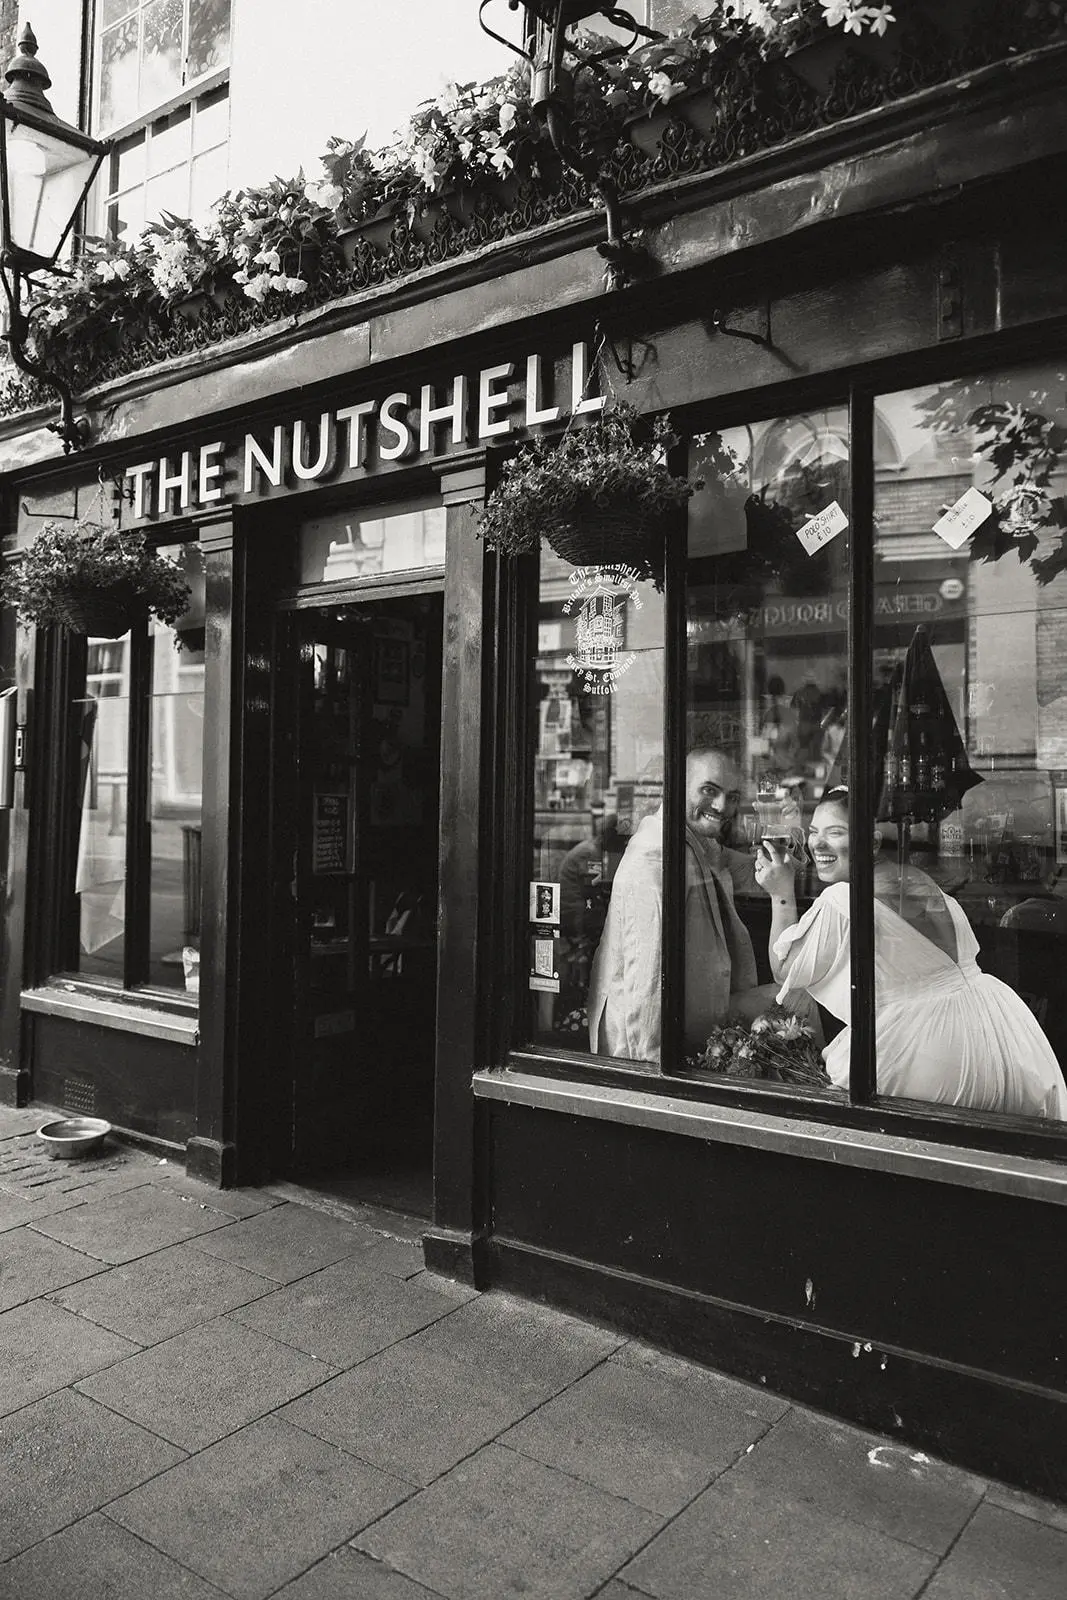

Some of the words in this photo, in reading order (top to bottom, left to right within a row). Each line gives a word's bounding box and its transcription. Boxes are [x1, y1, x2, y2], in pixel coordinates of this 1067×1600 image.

[125, 441, 226, 518] THE
[244, 342, 607, 493] NUTSHELL
[804, 522, 820, 539] POLO
[820, 506, 838, 526] SHIRT
[568, 566, 591, 585] The
[561, 577, 593, 615] Britain's
[594, 573, 632, 591] Smallest
[628, 588, 644, 610] Pub
[563, 652, 584, 677] Bury
[585, 670, 600, 683] St.
[582, 682, 618, 696] Suffolk
